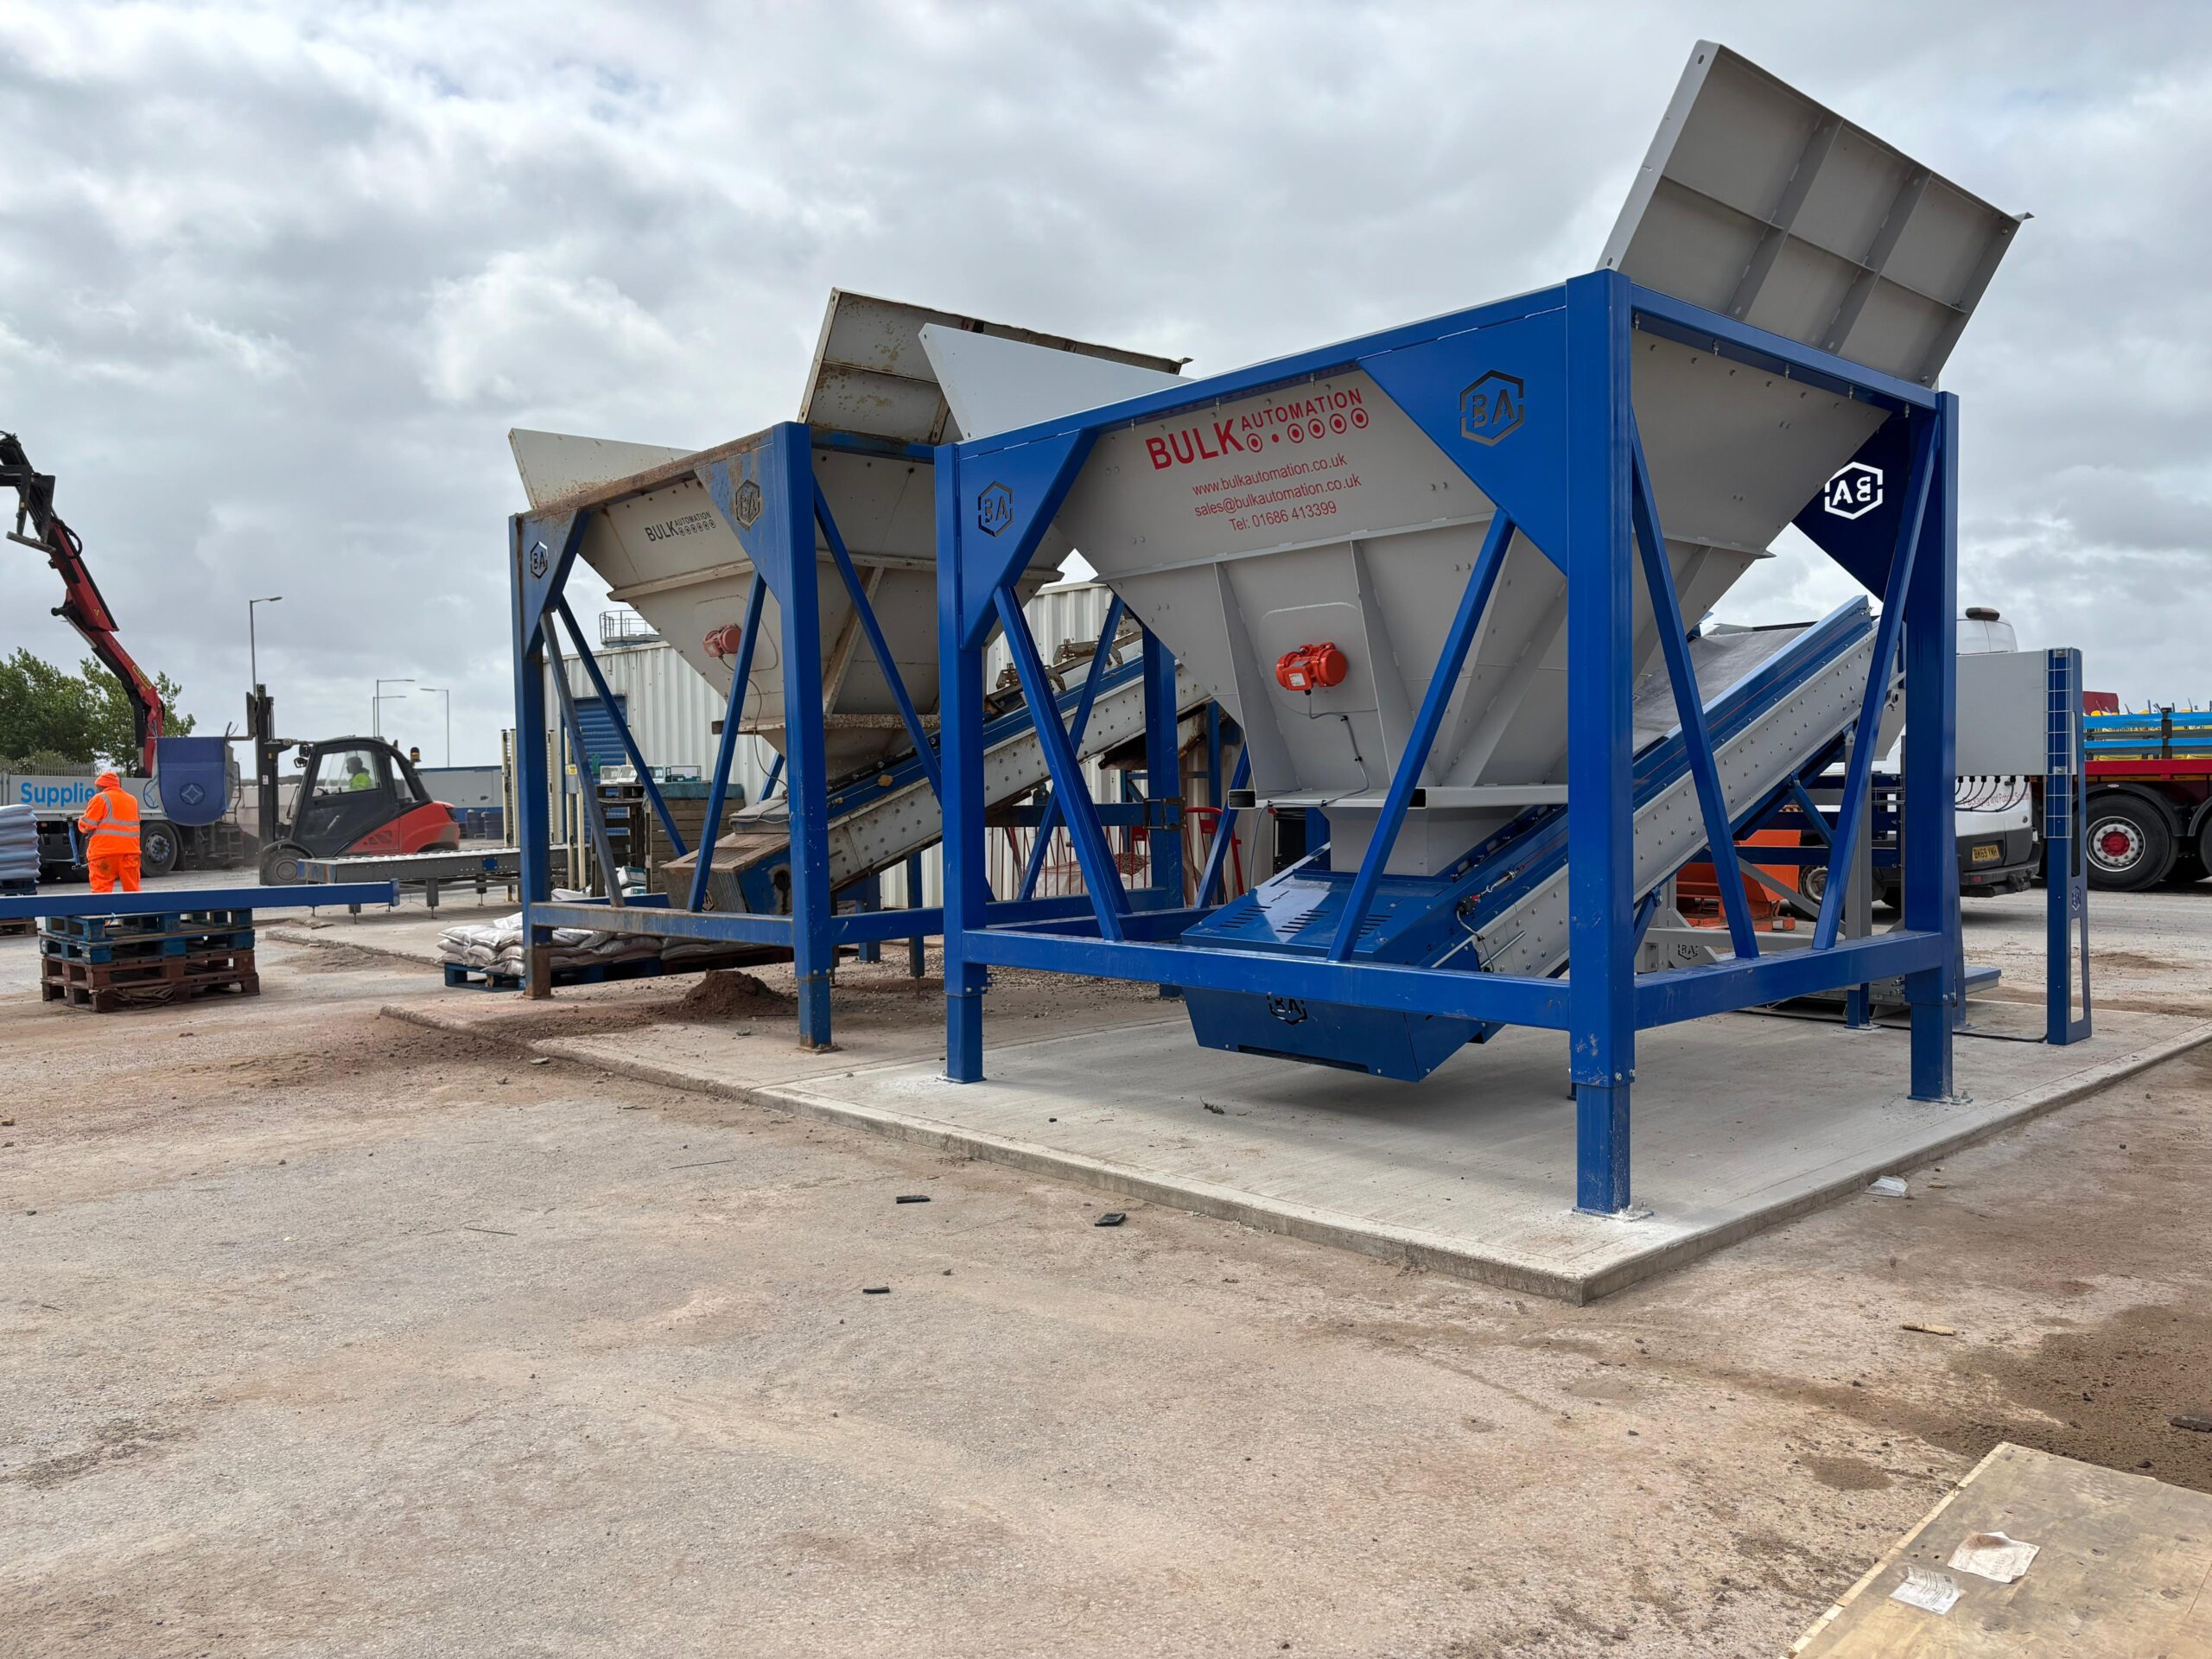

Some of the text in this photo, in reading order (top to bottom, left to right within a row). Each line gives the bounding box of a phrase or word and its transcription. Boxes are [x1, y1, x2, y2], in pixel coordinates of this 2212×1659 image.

[1146, 388, 1363, 470] BULK AUTOMATION
[1472, 389, 1516, 429] BA
[1192, 452, 1347, 496] www.bulkautomation.co.uk
[985, 496, 1009, 524] BA
[1194, 474, 1362, 517] sales@bulkautomation.co.uk
[1229, 500, 1338, 531] Tel: 01686 413399
[645, 512, 712, 542] BULK AUTOMATION
